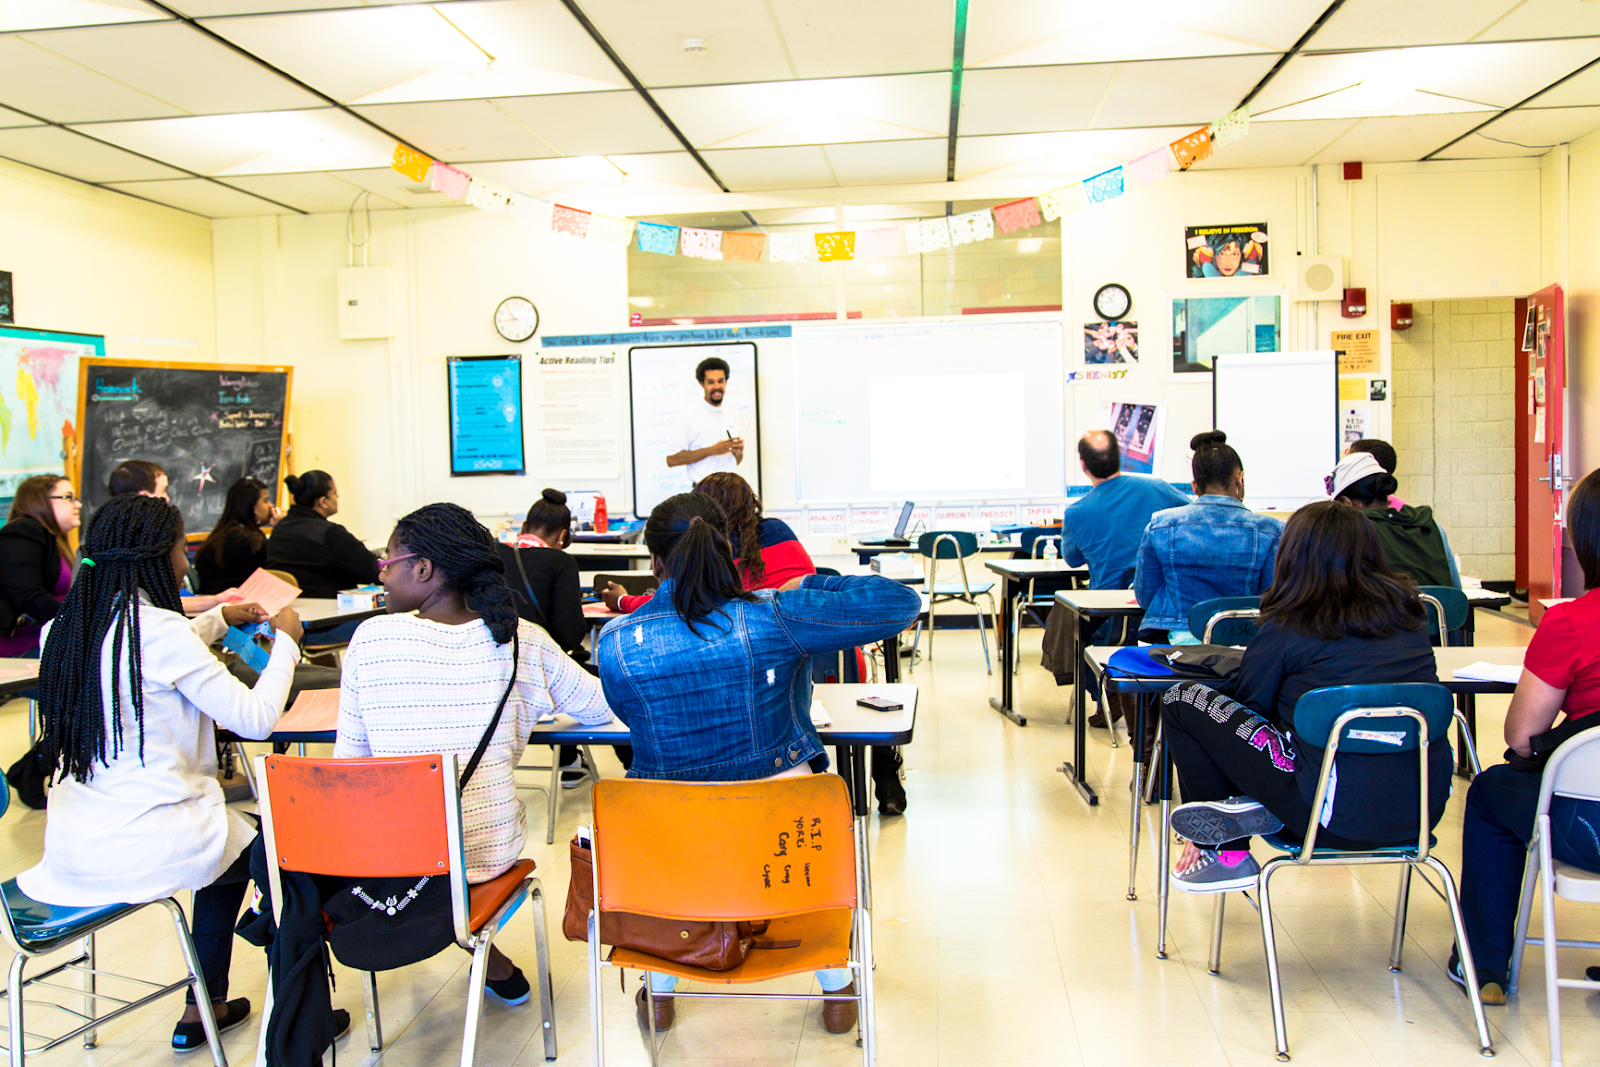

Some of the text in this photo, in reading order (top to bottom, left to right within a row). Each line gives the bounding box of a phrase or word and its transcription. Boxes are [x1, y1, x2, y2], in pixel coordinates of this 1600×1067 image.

[565, 356, 597, 365] Reading
[599, 356, 615, 364] Tips
[937, 512, 972, 520] SUPPORT
